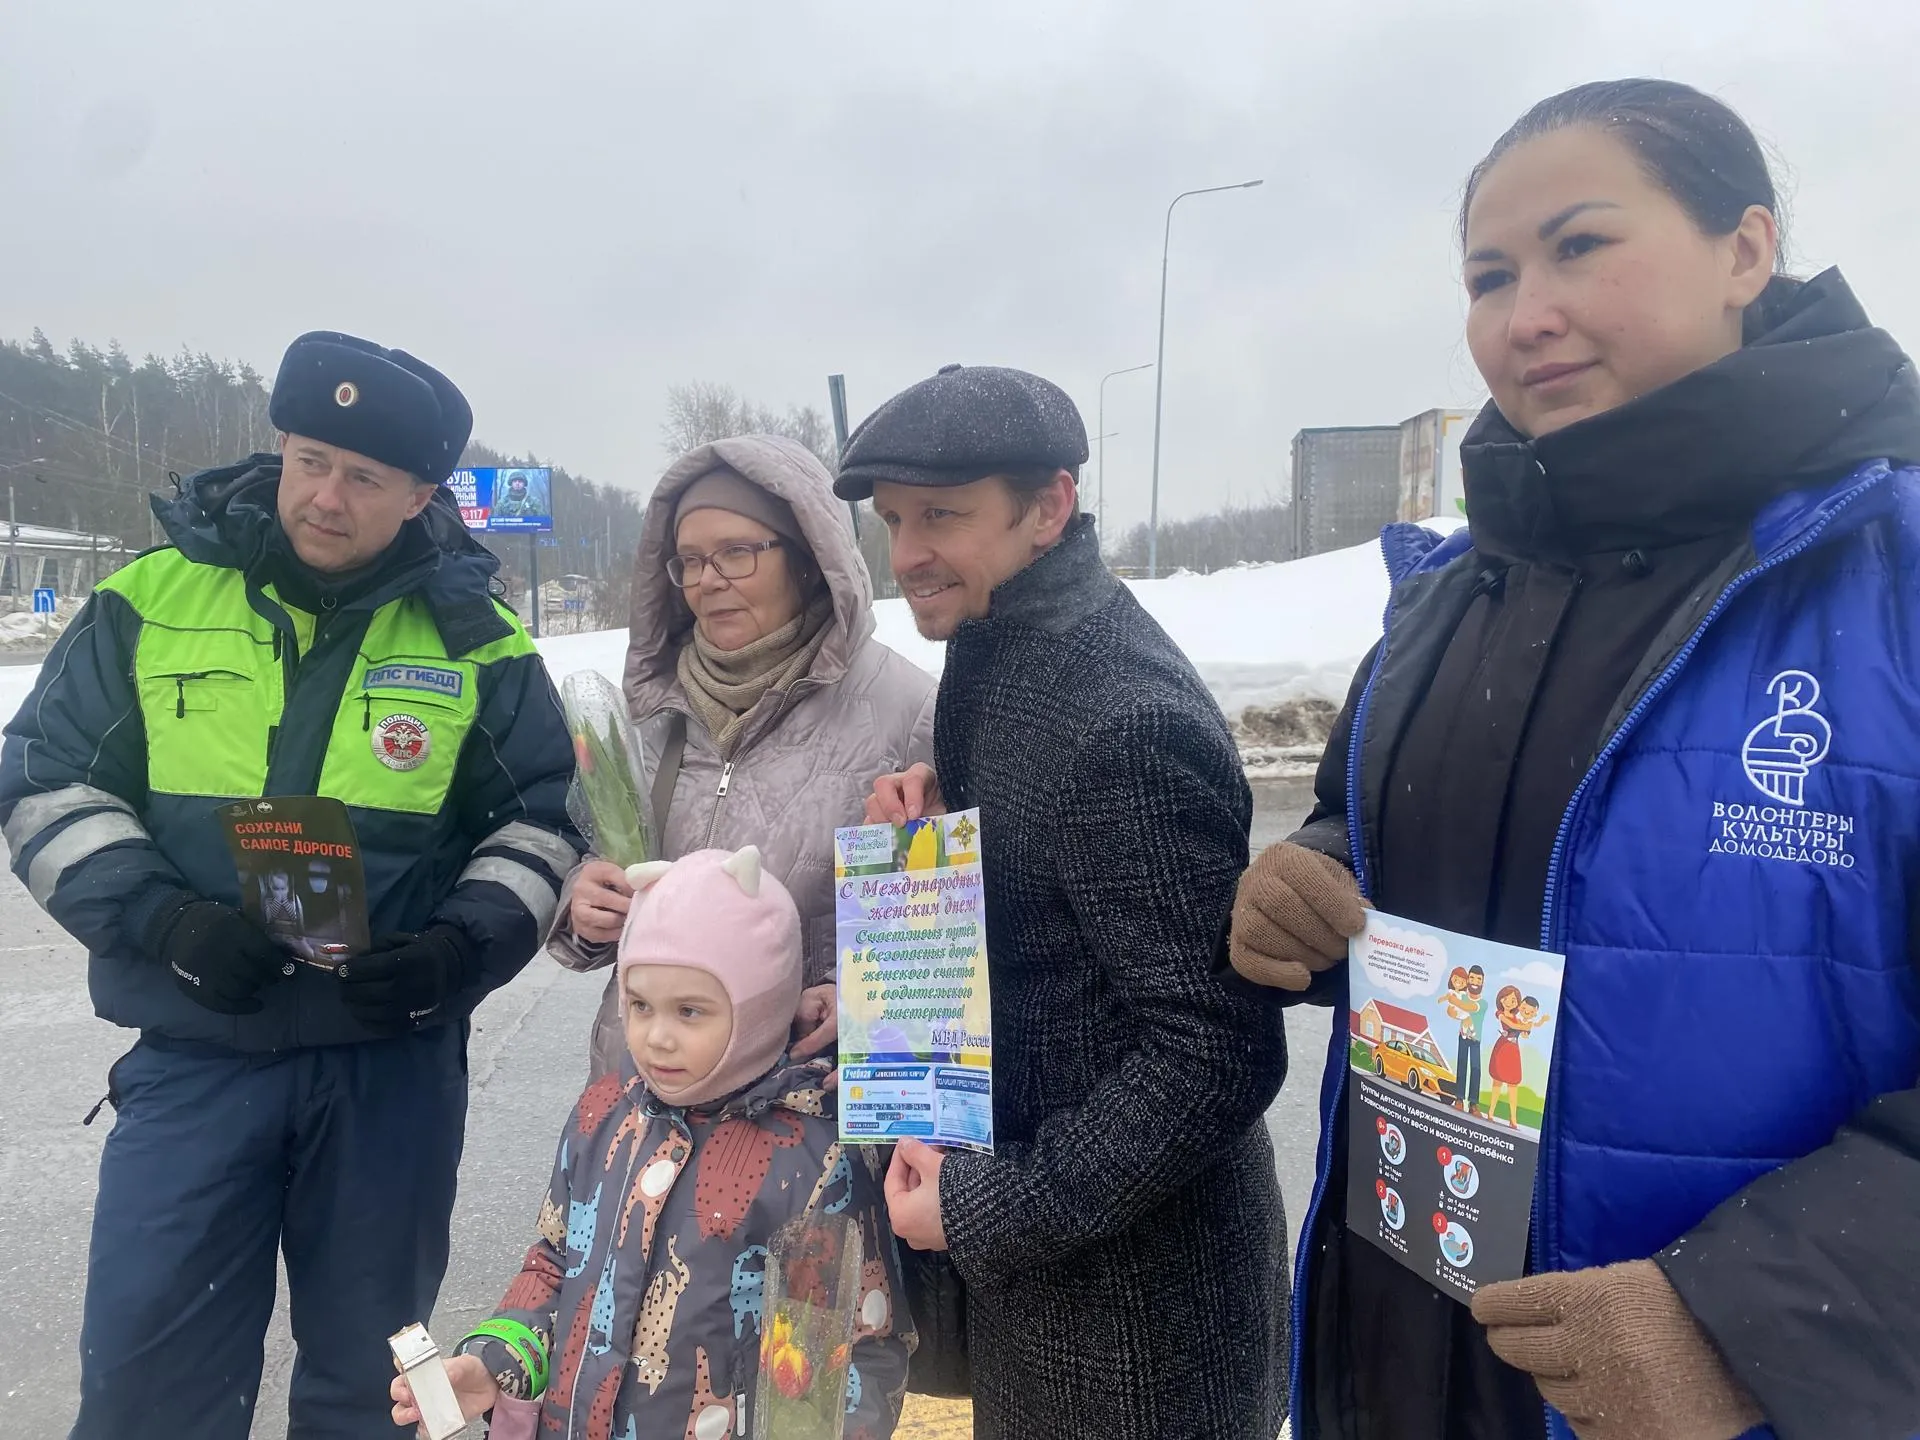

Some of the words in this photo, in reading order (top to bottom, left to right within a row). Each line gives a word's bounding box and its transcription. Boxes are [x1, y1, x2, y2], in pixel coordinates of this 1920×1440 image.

[470, 509, 484, 520] 117
[370, 669, 402, 684] ДПС
[406, 670, 456, 689] ГИБДД
[380, 714, 428, 732] ПОЛИЦИЯ
[392, 748, 413, 759] ДПС
[1712, 802, 1854, 834] ВОЛОНТЕРЫ
[234, 822, 303, 835] СОХРАНИ
[1722, 820, 1844, 851] КУЛЬТУРЫ
[240, 838, 290, 852] САМОЕ
[294, 841, 353, 858] ДОРОГОЕ
[1709, 838, 1854, 868] ДОМОДЕДОВО
[840, 881, 854, 899] С
[868, 901, 940, 920] женским
[945, 894, 977, 914] днем!
[856, 927, 943, 944] Счастливых
[946, 922, 977, 940] путей
[852, 952, 862, 964] и
[866, 946, 946, 962] безопасных
[948, 943, 978, 960] дорог,
[1368, 934, 1404, 950] Перевозка
[1405, 946, 1424, 956] детей
[862, 968, 930, 982] женского
[933, 965, 976, 979] счастья
[866, 989, 877, 1001] и
[880, 984, 973, 1000] водительского
[880, 1004, 966, 1022] мастерства!
[930, 1030, 958, 1048] МВД
[960, 1030, 990, 1048] России
[1360, 1080, 1380, 1098] Группы
[1380, 1094, 1406, 1110] детских
[1407, 1106, 1468, 1136] удерживающих
[1469, 1129, 1515, 1151] устройств
[1364, 1096, 1402, 1121] зависимости
[1402, 1116, 1410, 1124] от
[1410, 1120, 1429, 1132] веса
[1430, 1128, 1435, 1136] и
[1436, 1130, 1473, 1150] возраста
[1474, 1144, 1514, 1164] ребёнка
